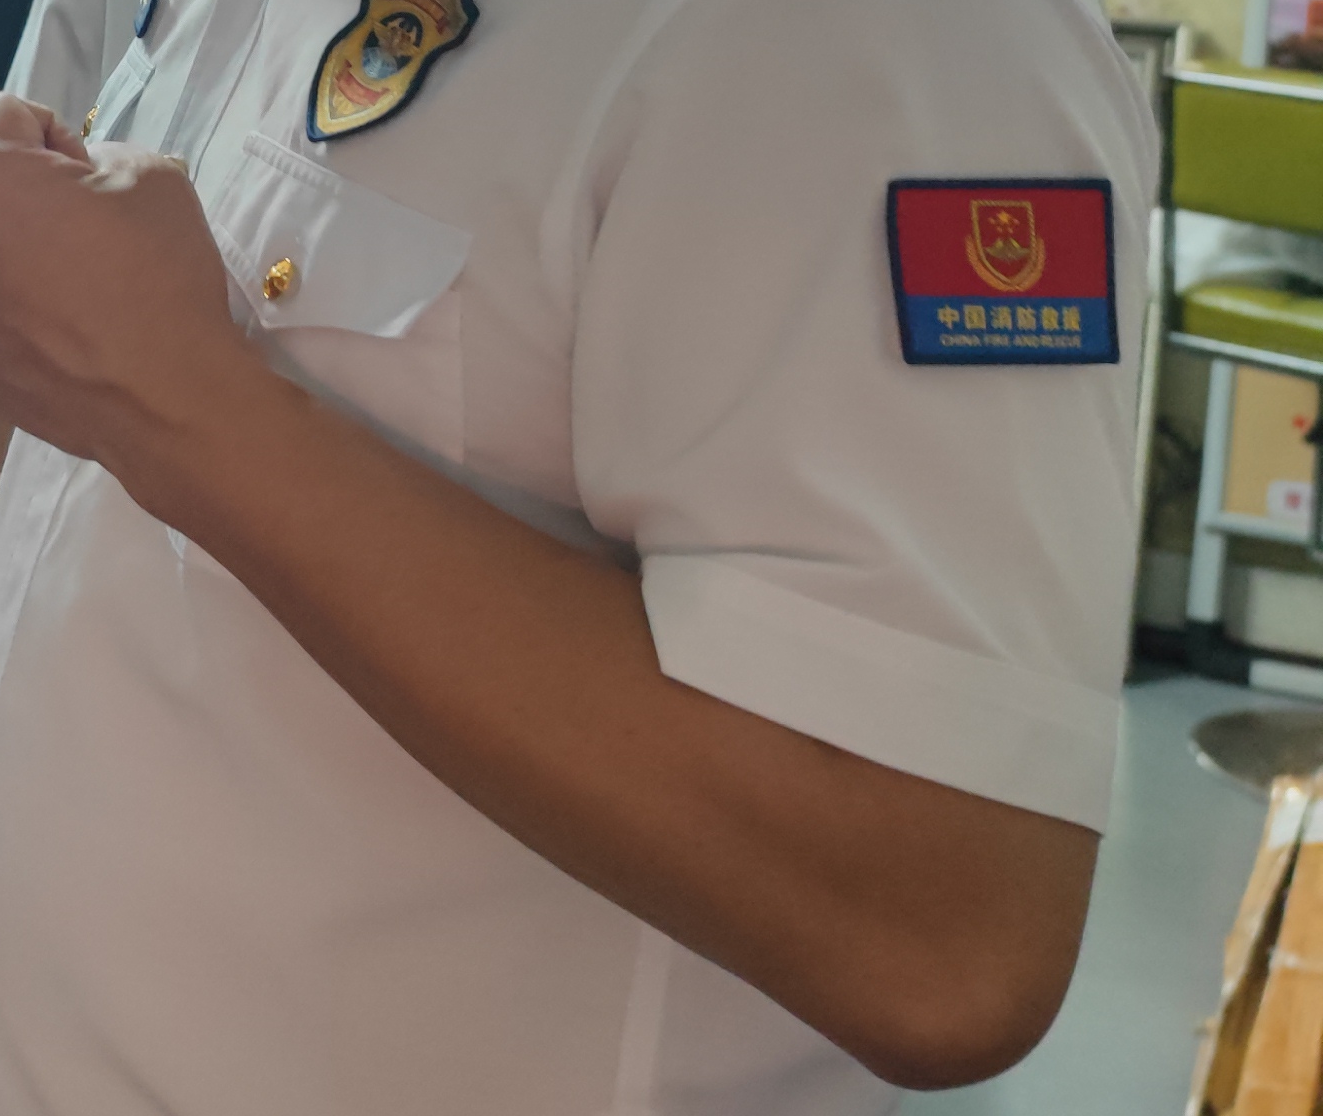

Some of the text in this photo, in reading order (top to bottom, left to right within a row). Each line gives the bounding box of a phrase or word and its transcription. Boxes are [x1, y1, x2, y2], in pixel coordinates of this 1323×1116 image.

[937, 304, 1081, 331] 中国消防救援
